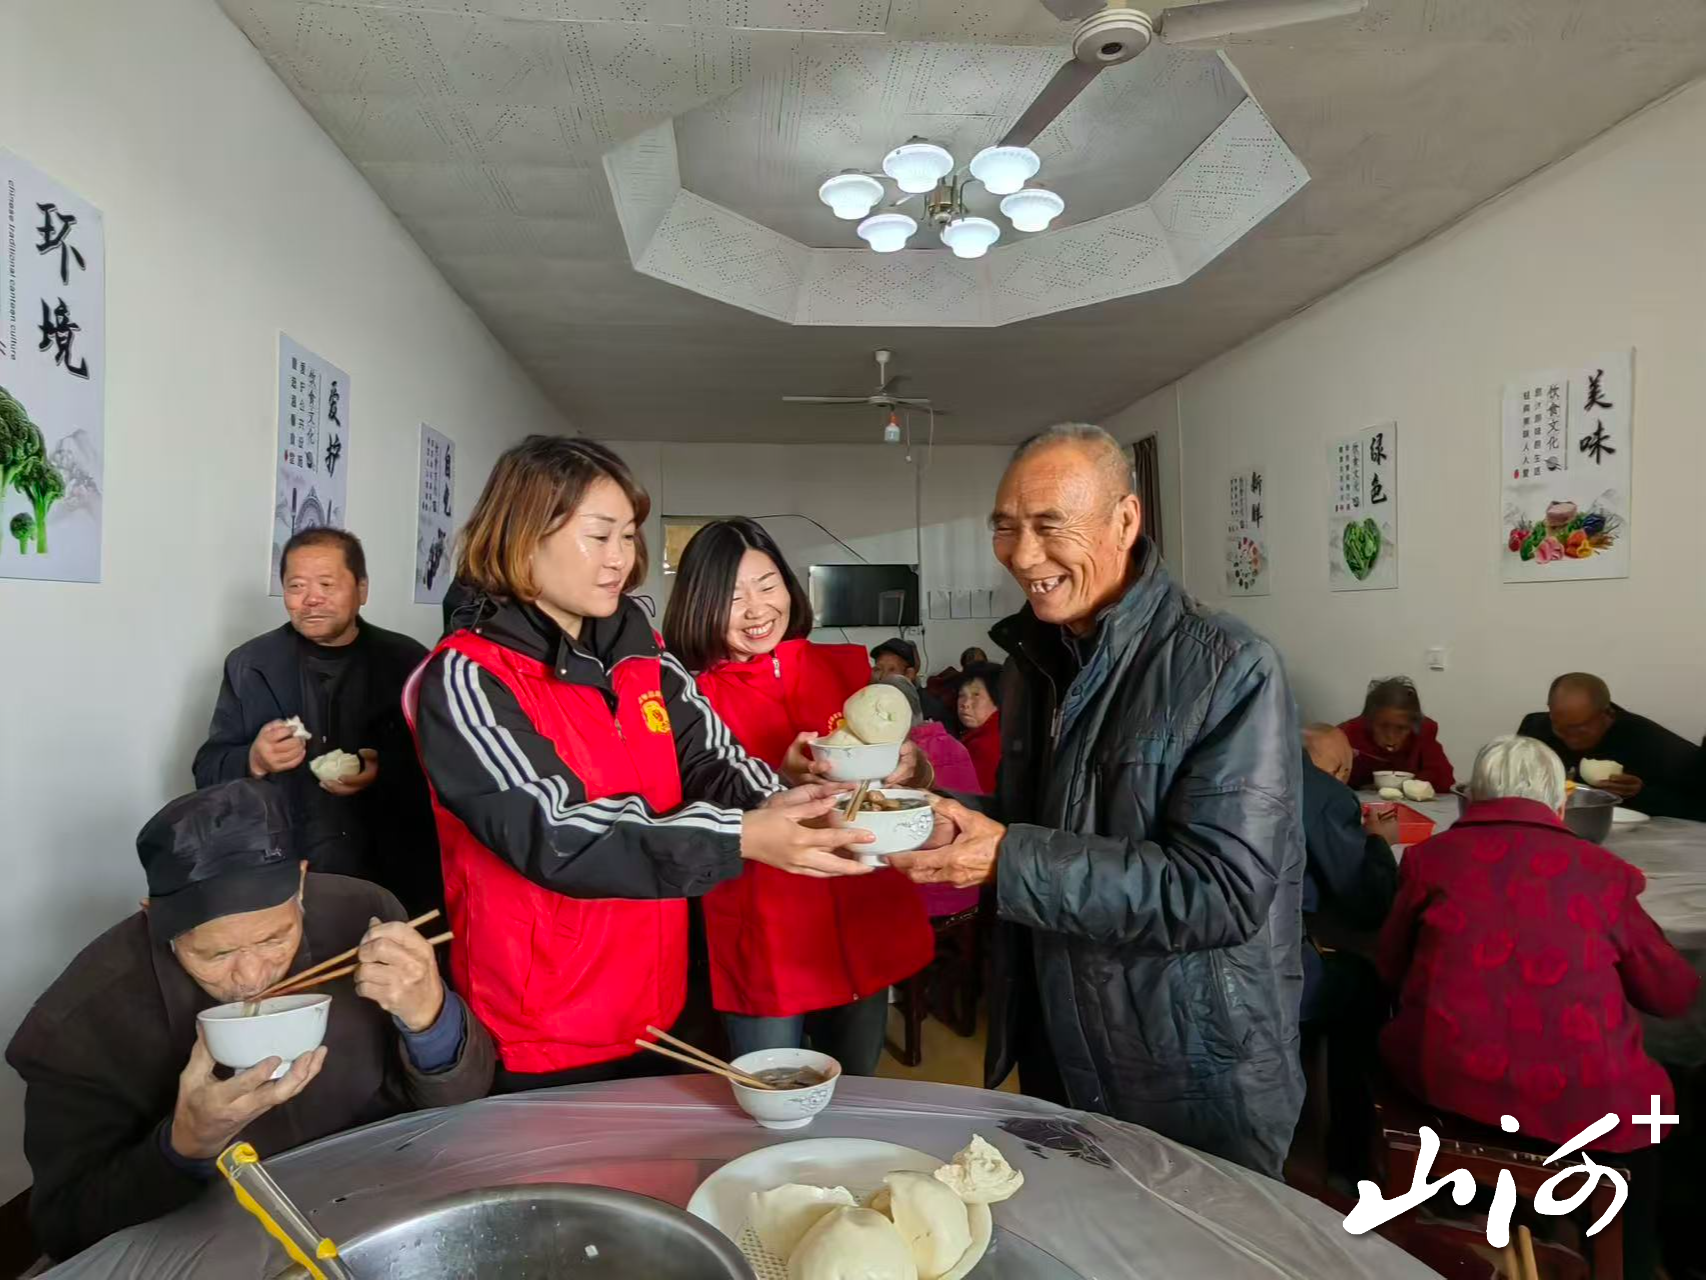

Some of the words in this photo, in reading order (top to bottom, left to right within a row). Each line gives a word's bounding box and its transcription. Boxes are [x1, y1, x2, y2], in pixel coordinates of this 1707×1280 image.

[36, 201, 90, 379] 环境
[324, 379, 342, 479] 爱护
[1546, 383, 1560, 451] 饮食文化
[1579, 368, 1617, 466] 美味
[1369, 432, 1388, 505] 绿色
